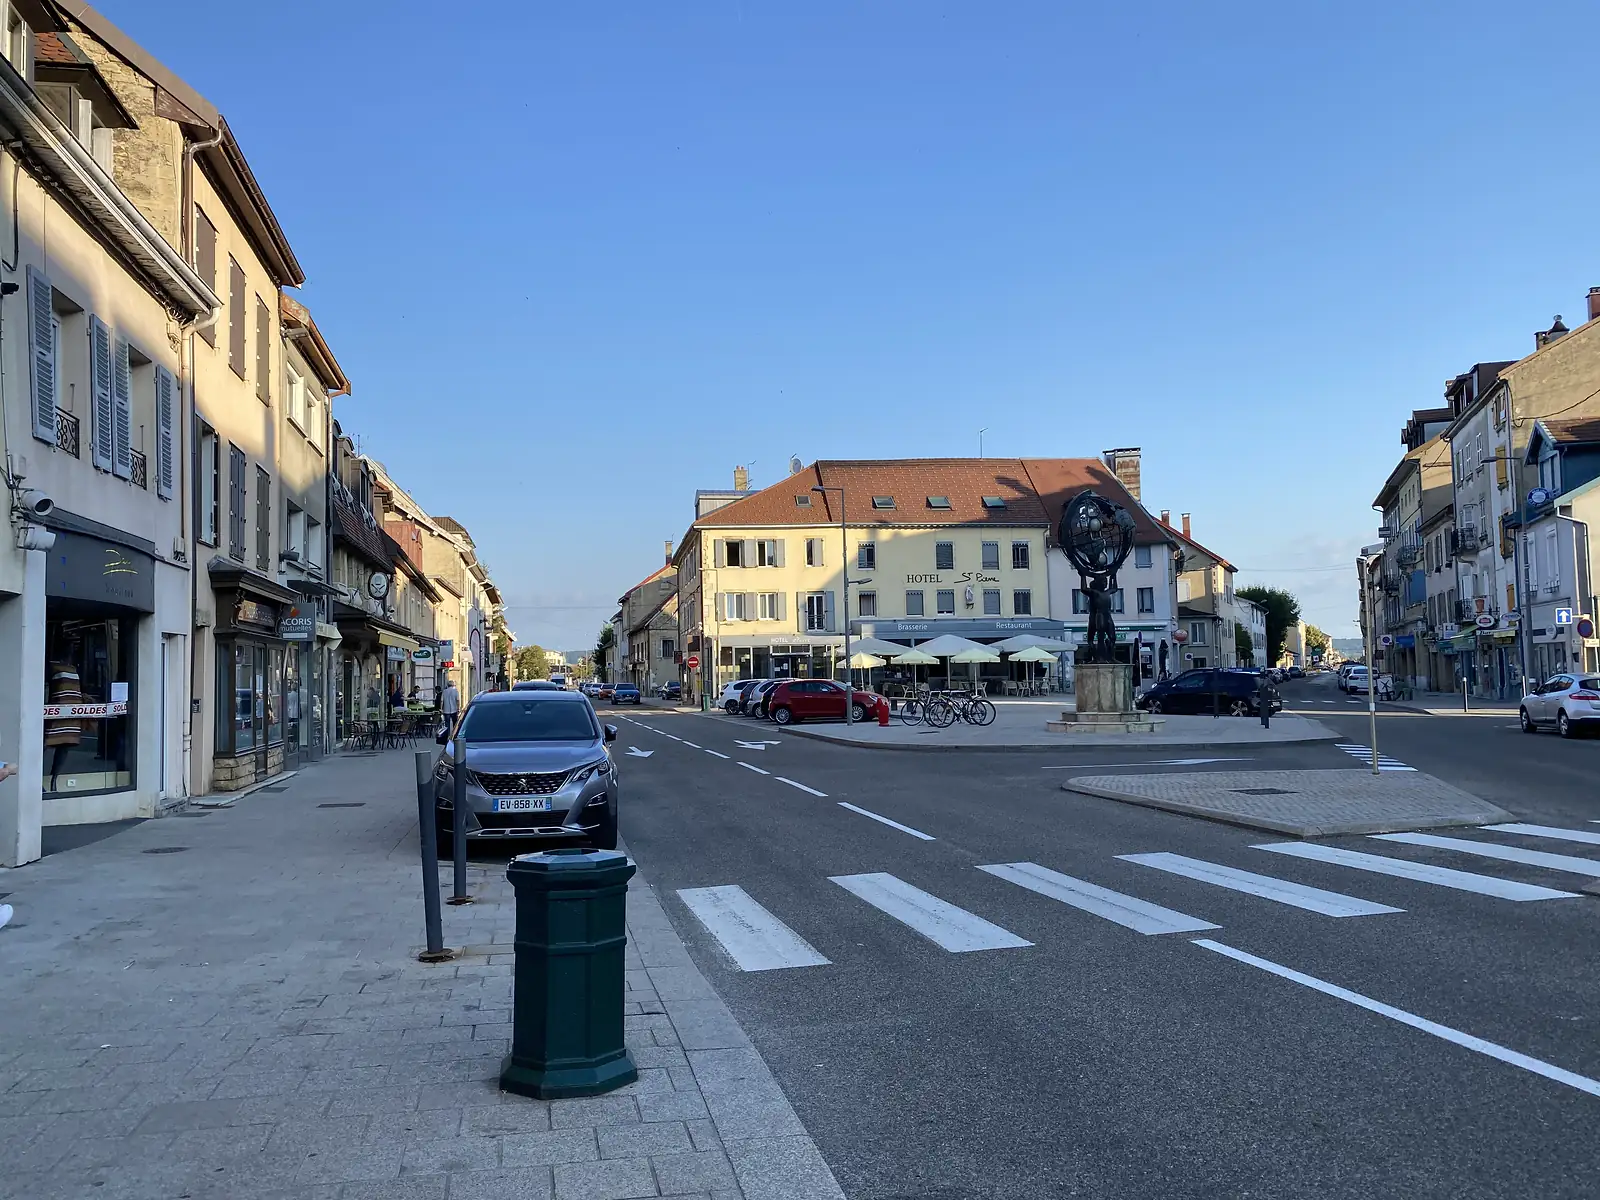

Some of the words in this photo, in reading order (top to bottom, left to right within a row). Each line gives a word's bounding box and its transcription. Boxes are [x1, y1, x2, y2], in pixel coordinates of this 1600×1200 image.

[907, 574, 942, 583] HOTEL
[71, 707, 107, 715] SOLDES
[500, 799, 544, 809] EV-858-XX
